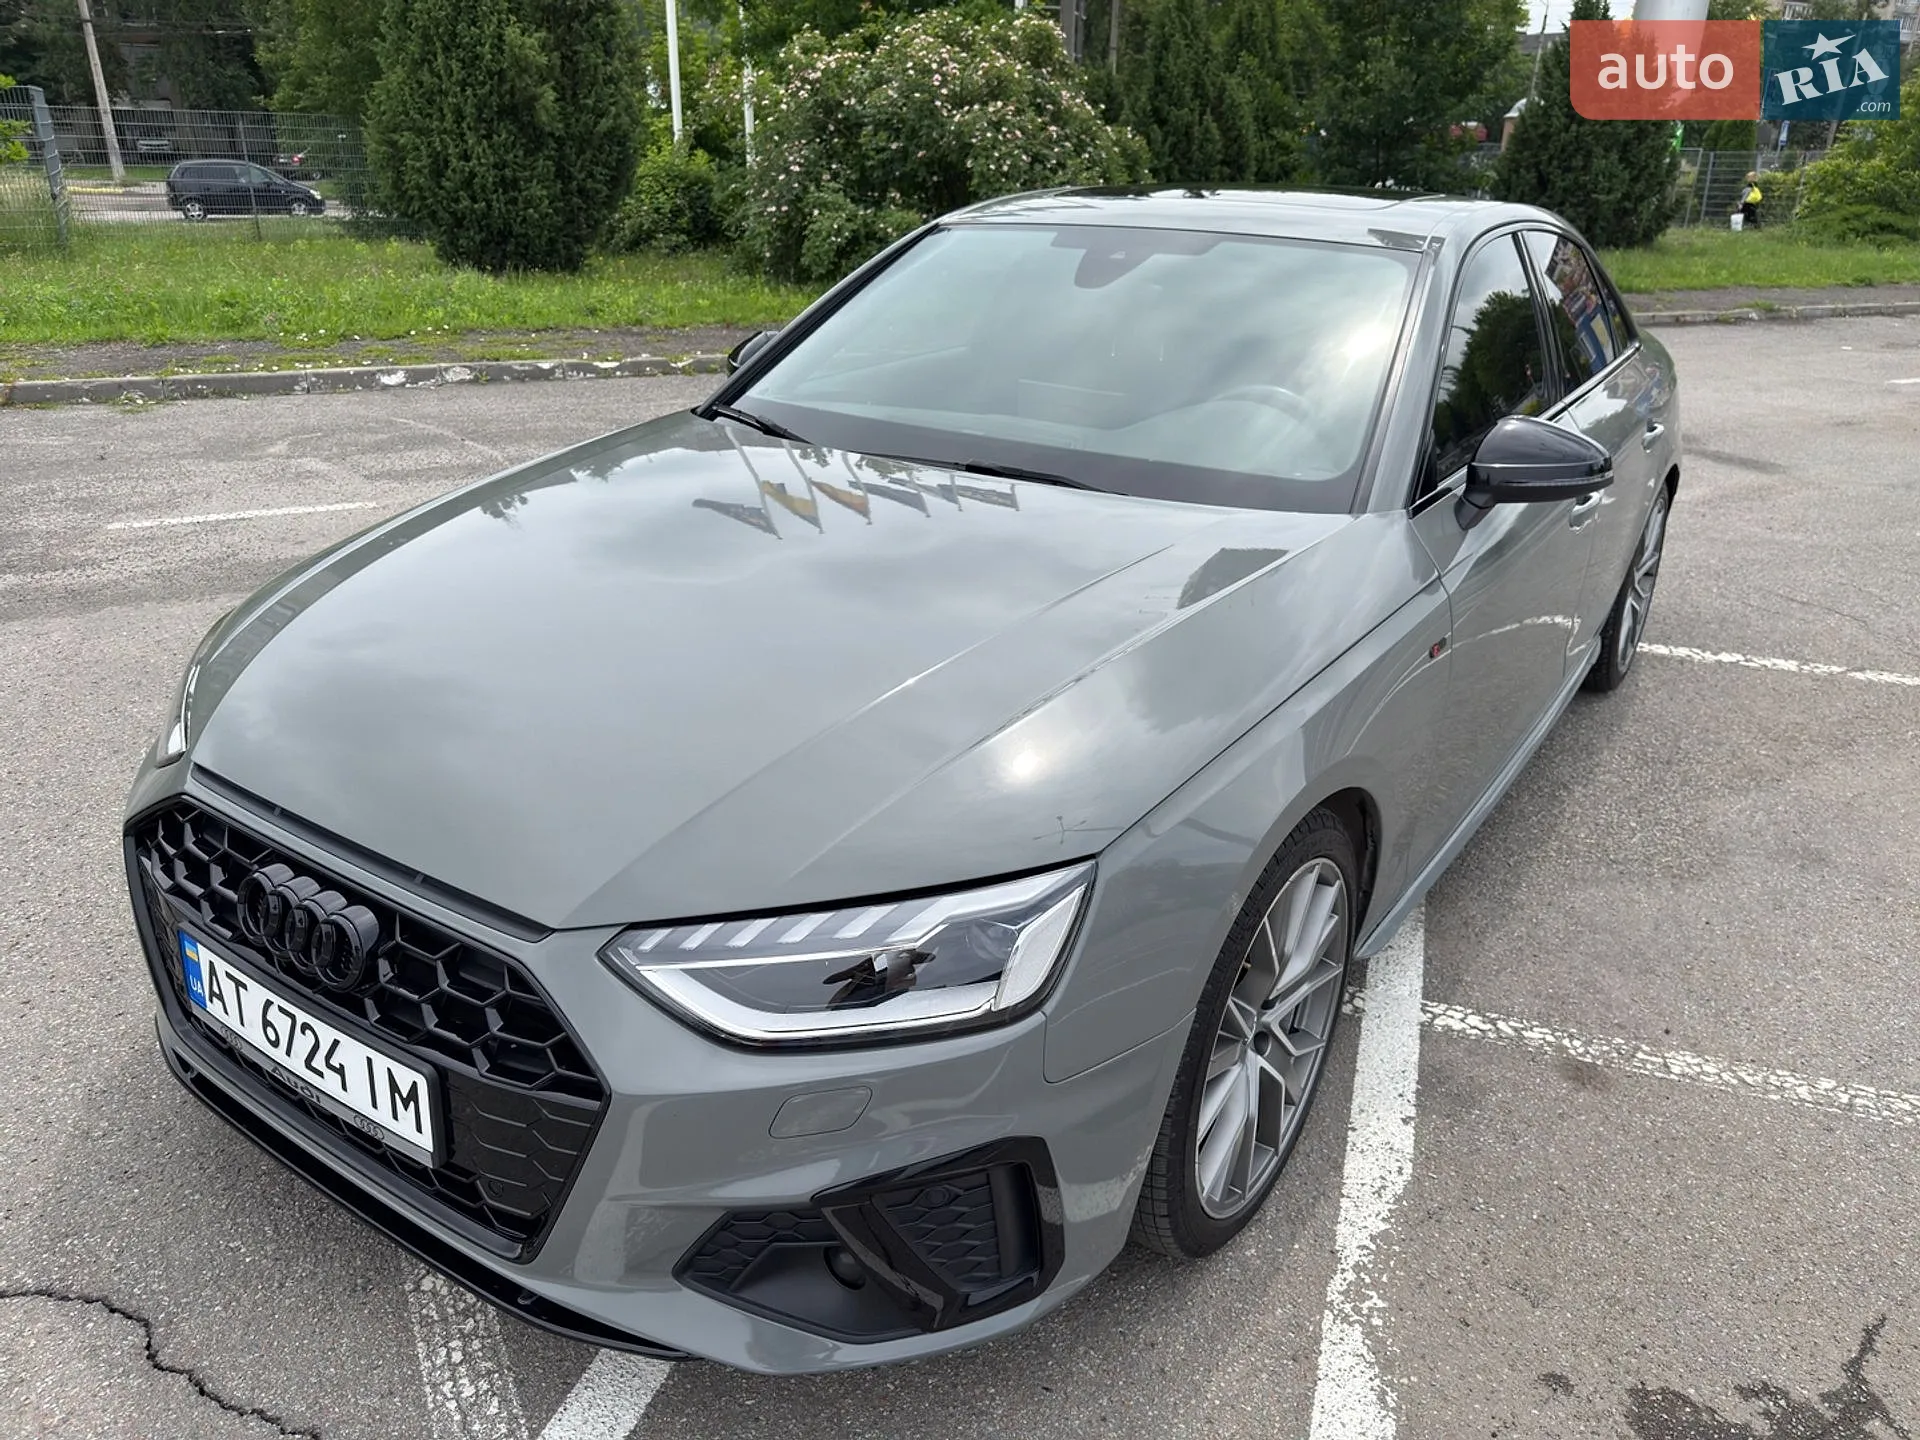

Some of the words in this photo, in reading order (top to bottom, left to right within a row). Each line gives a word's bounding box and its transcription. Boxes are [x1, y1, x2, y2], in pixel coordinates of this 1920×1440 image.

[189, 974, 204, 997] UA
[208, 959, 248, 1028] AT
[261, 998, 348, 1094] 6724
[366, 1055, 423, 1135] IM
